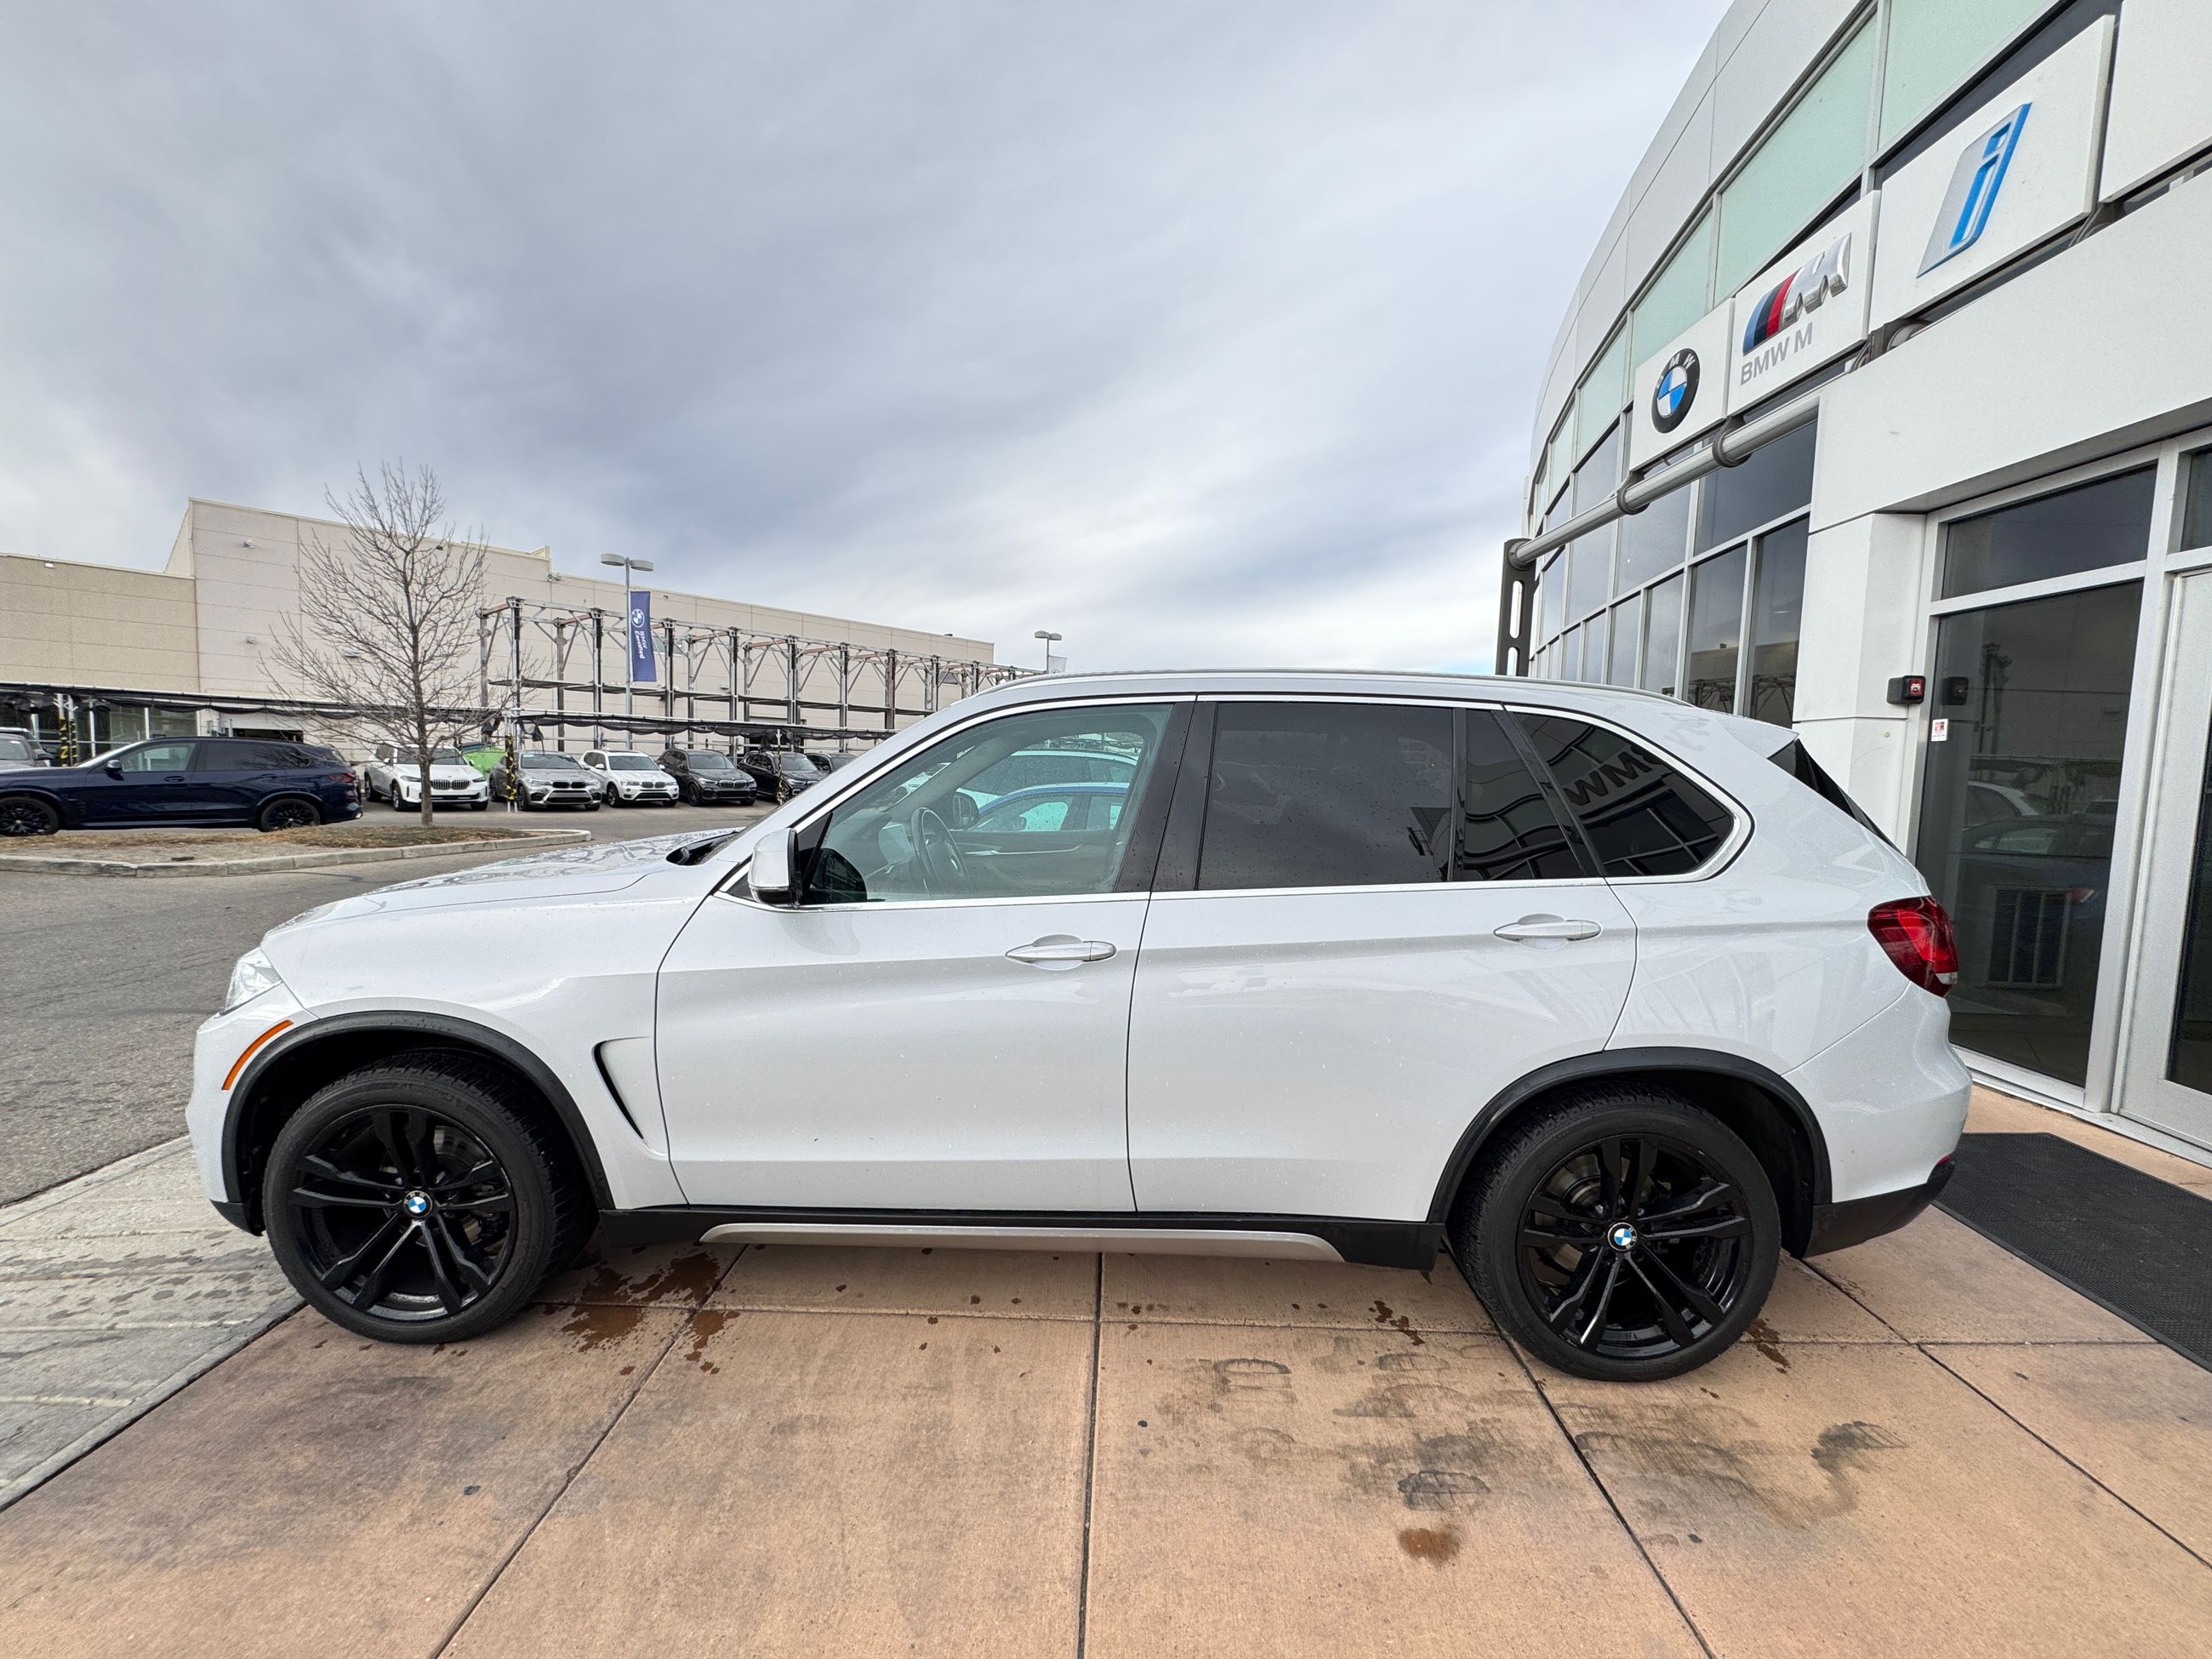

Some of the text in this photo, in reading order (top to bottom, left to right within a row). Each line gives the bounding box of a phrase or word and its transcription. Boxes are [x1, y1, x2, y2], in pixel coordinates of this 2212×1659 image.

[1740, 322, 1813, 386] BMW M
[634, 630, 646, 659] Certified
[639, 630, 647, 649] BMW
